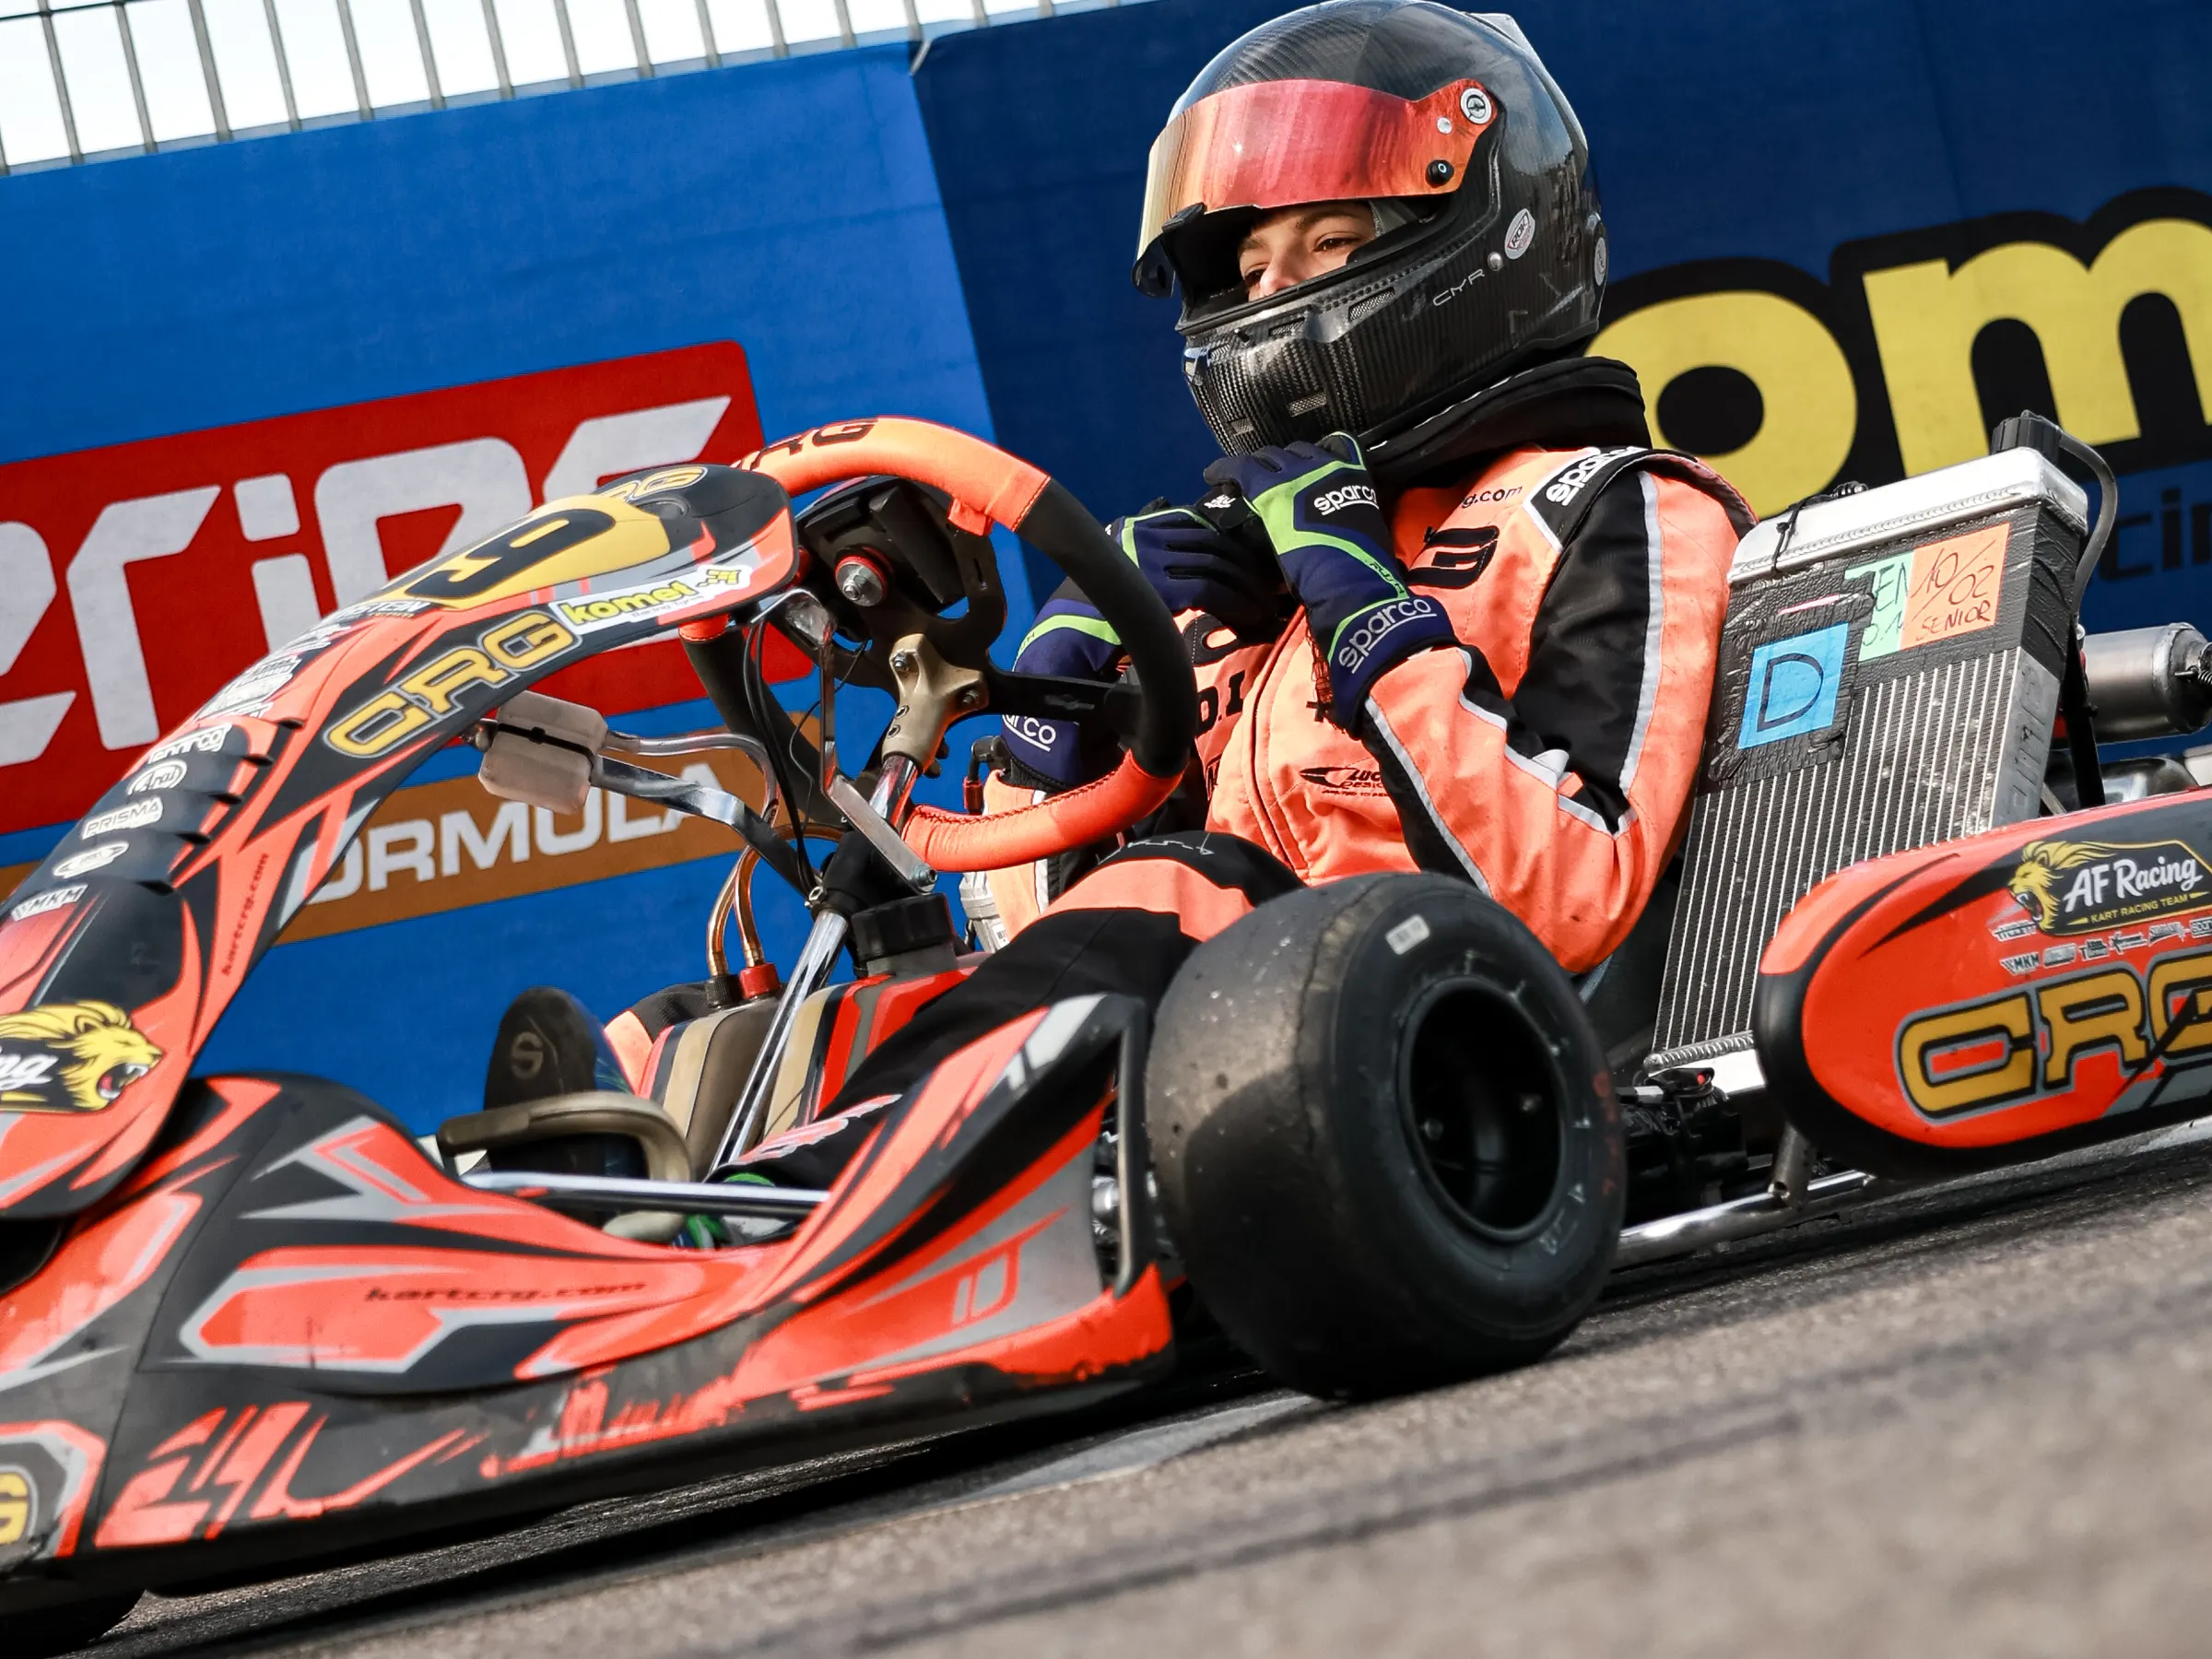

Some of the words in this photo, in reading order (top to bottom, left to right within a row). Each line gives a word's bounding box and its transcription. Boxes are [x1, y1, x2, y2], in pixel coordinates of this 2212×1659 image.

[559, 580, 700, 626] komet
[1338, 598, 1438, 674] sparco
[324, 611, 582, 759] CRG
[1757, 653, 1824, 733] D
[85, 800, 160, 833] PRISMA
[2063, 865, 2111, 912] AF
[2113, 856, 2203, 900] Racing
[2090, 910, 2118, 923] KART
[2121, 899, 2159, 915] RACING
[2159, 893, 2188, 908] TEAM
